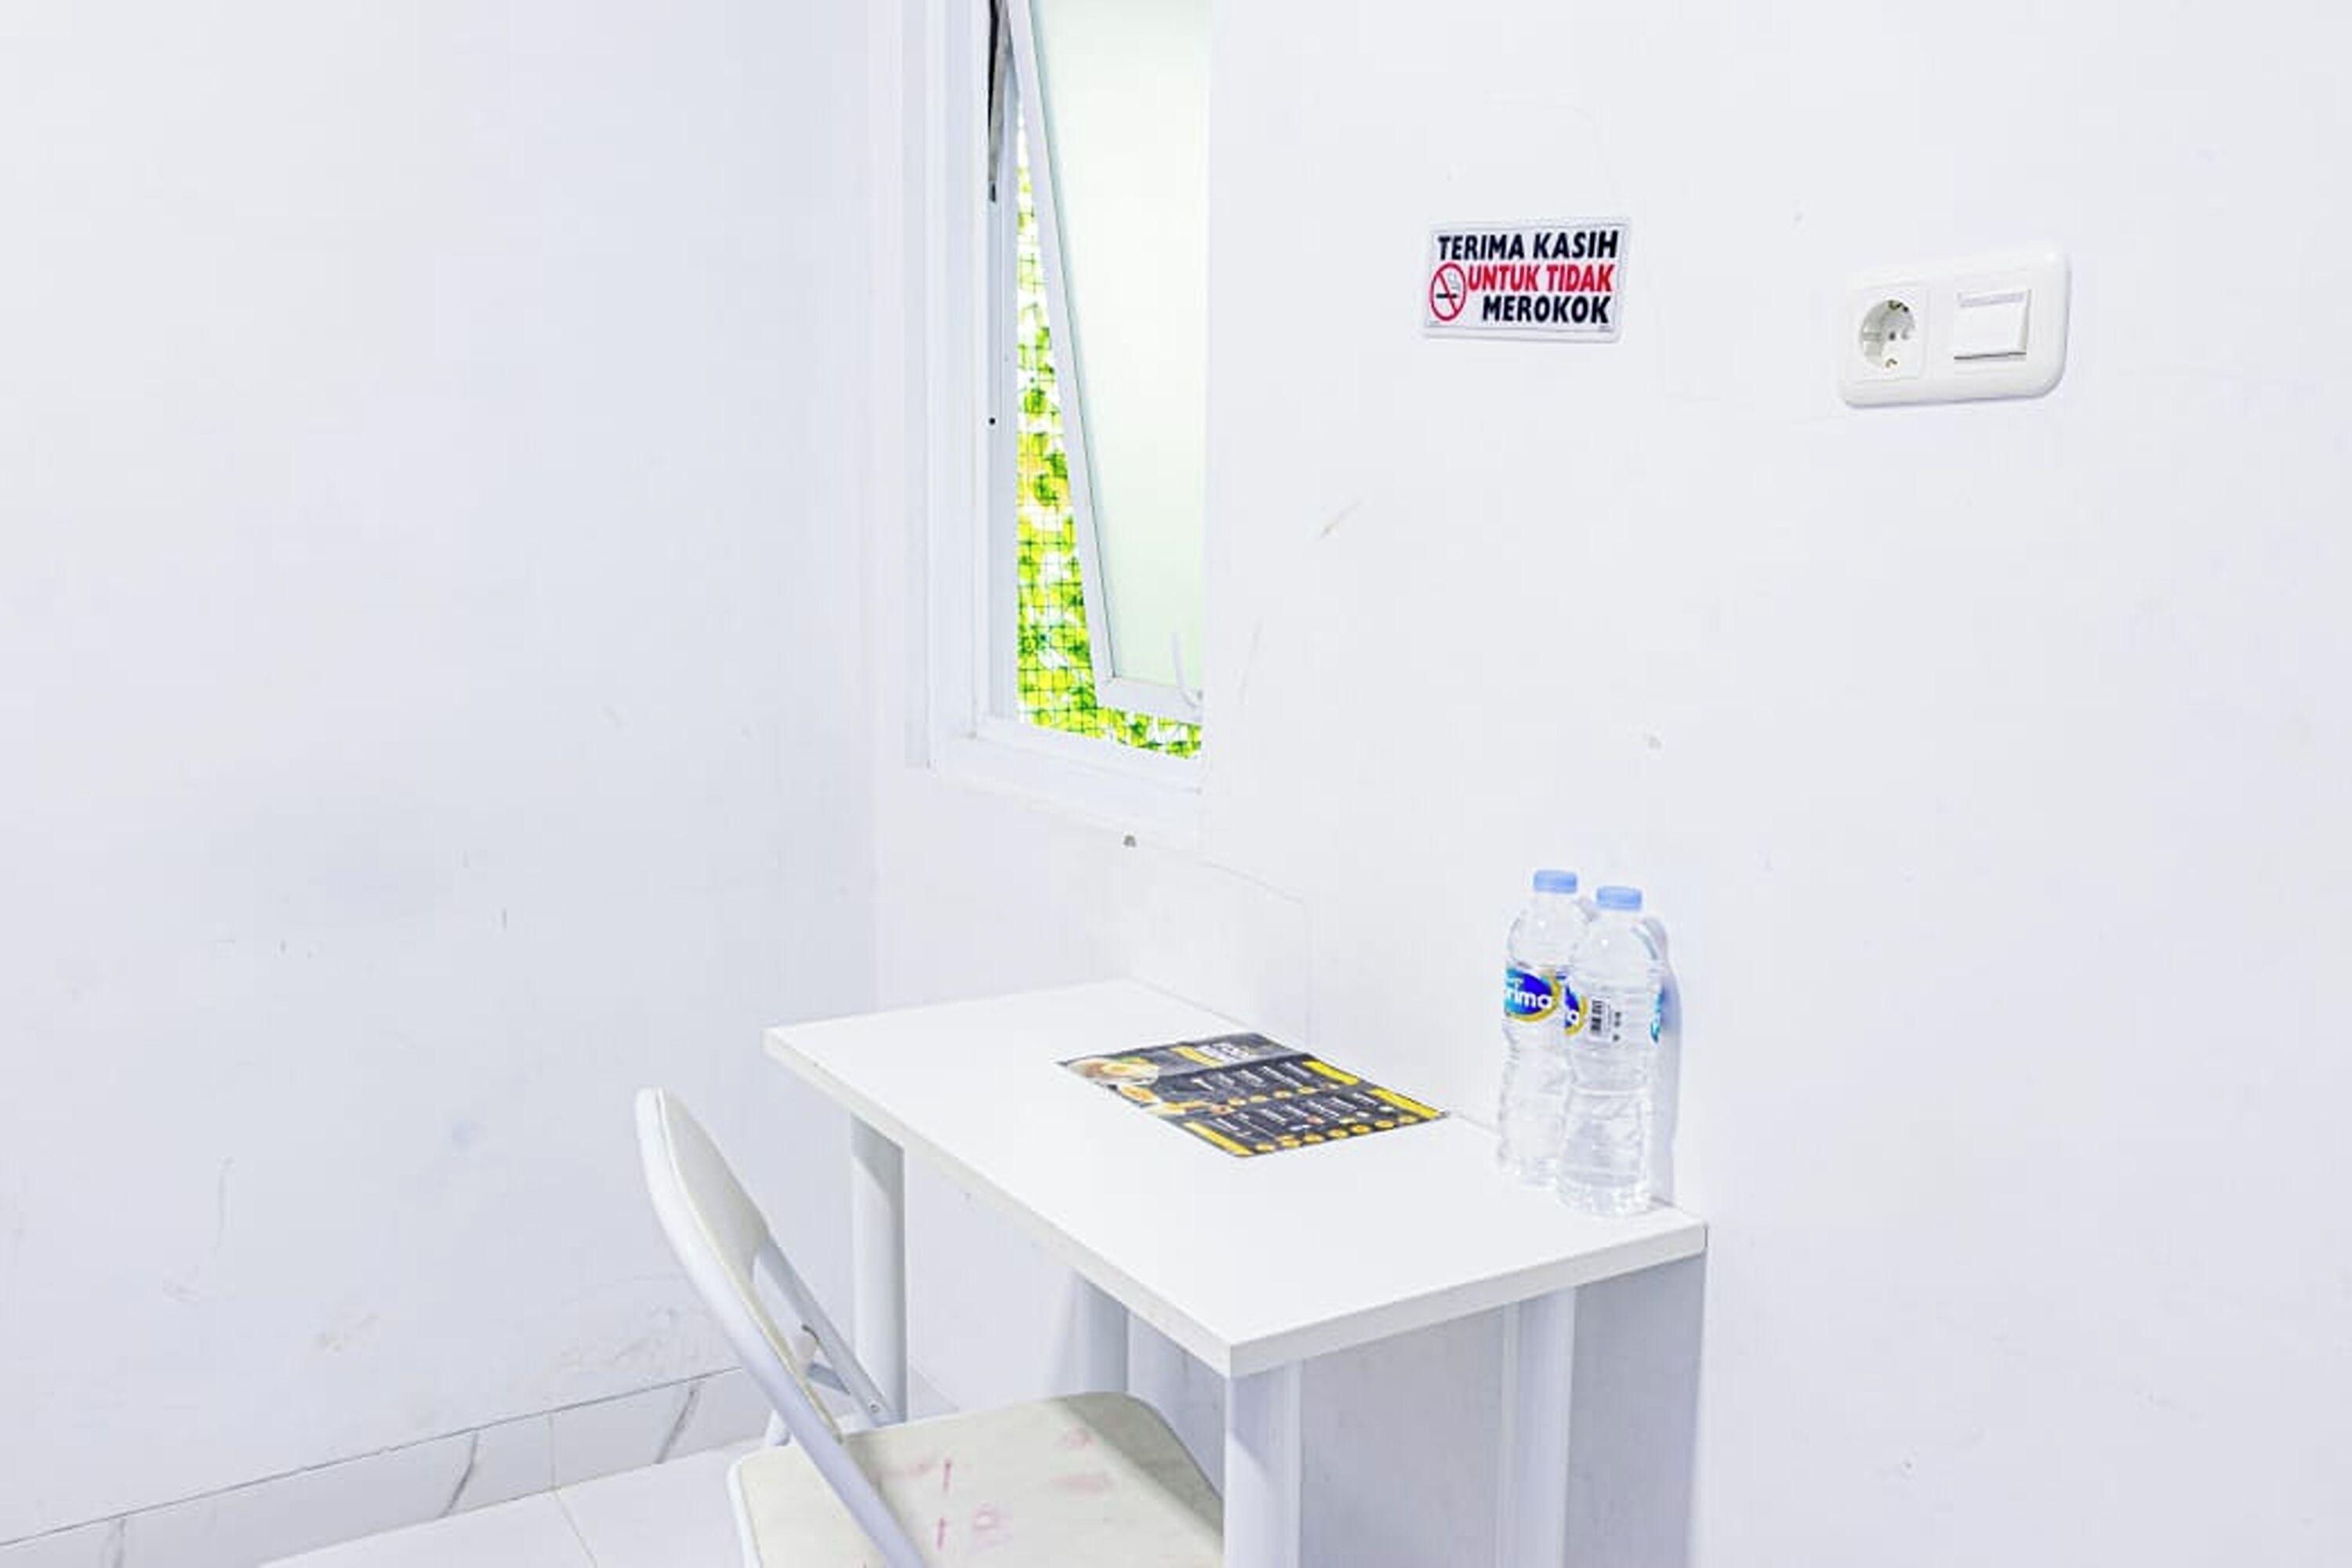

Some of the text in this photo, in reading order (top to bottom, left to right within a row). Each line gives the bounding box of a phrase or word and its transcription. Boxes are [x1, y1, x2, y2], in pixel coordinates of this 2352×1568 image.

[1438, 230, 1619, 260] TERIMA KASIH
[1468, 264, 1614, 292] UNTUK TIDAK
[1483, 295, 1610, 323] MEROKOK
